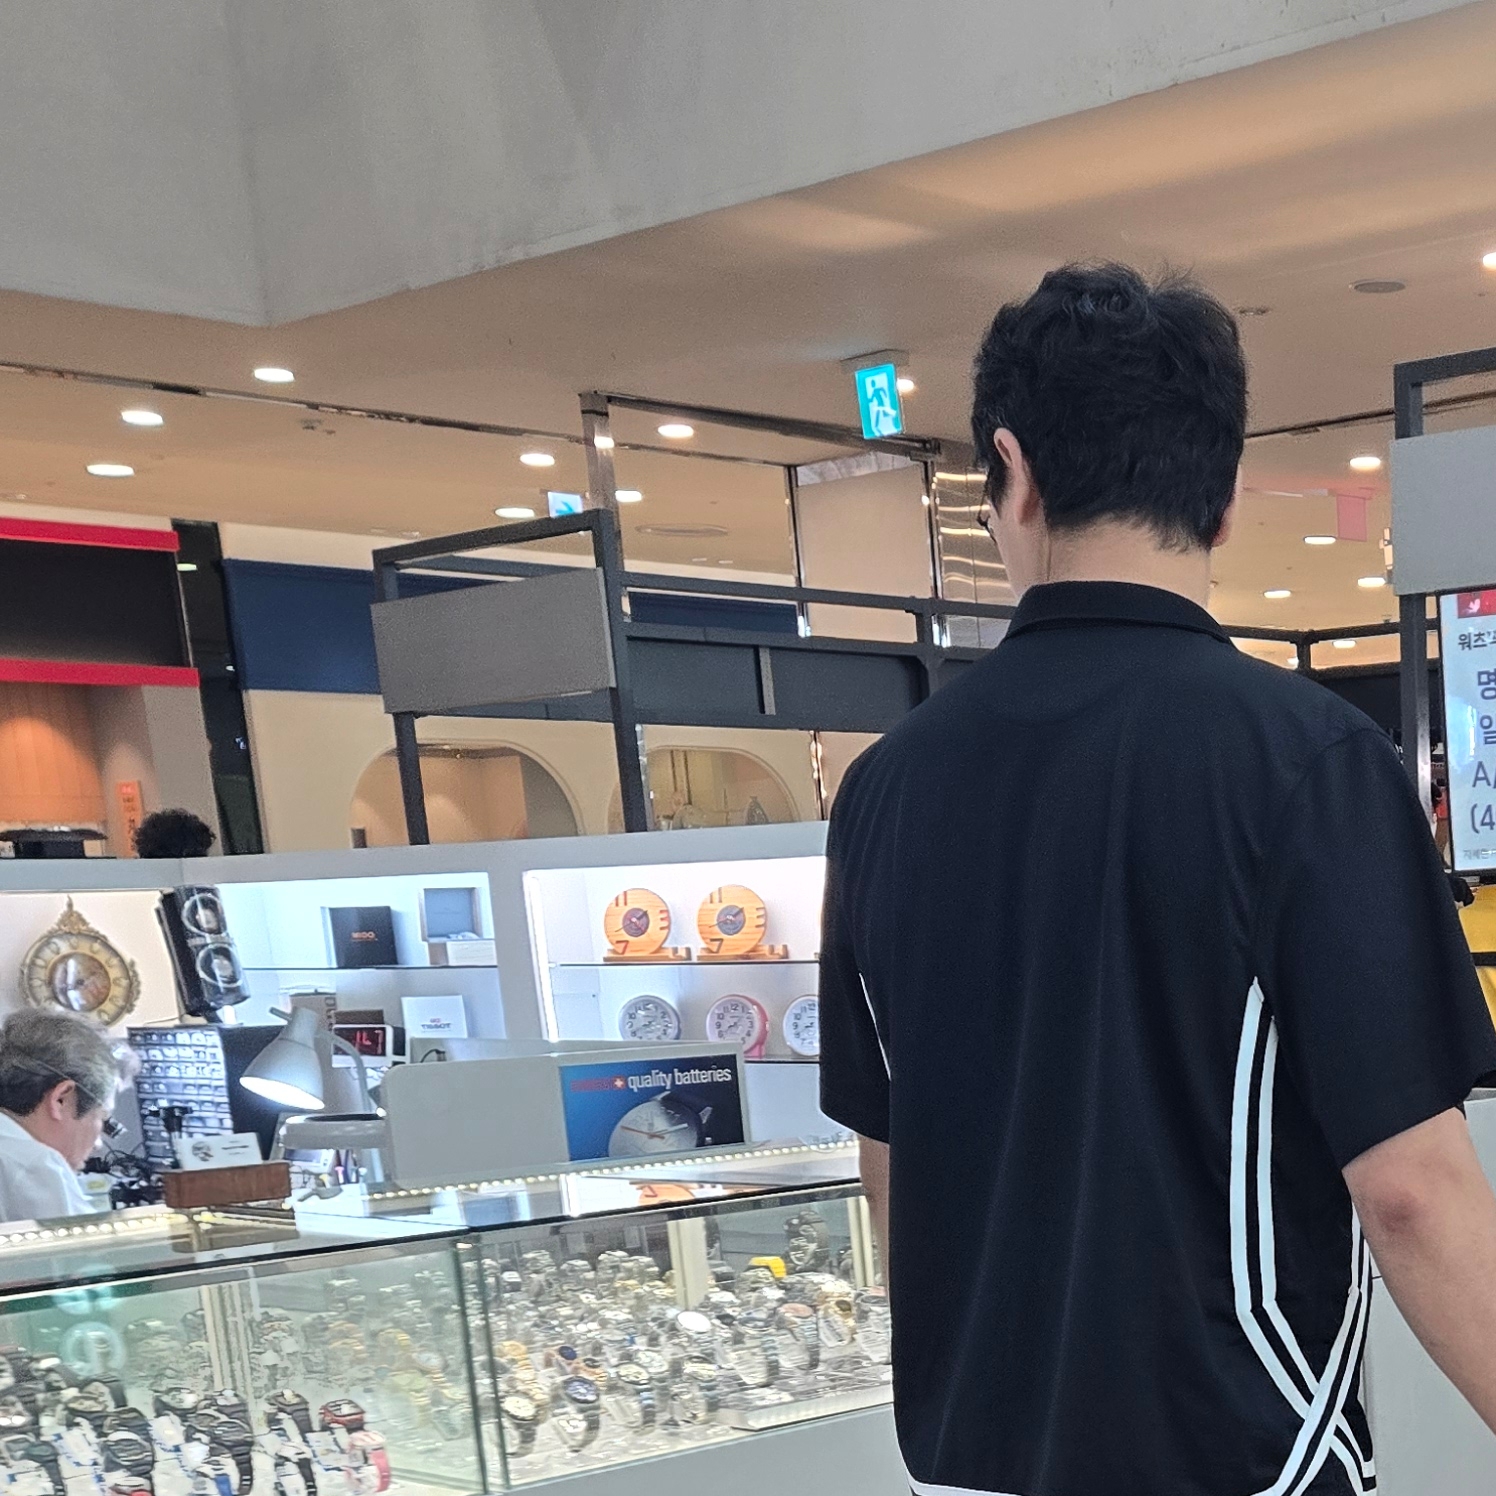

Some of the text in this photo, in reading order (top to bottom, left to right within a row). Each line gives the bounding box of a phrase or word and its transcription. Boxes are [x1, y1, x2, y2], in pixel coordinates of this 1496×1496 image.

[616, 940, 629, 955] 7
[710, 938, 724, 953] 7
[627, 1069, 672, 1092] quality
[674, 1067, 732, 1085] batteries
